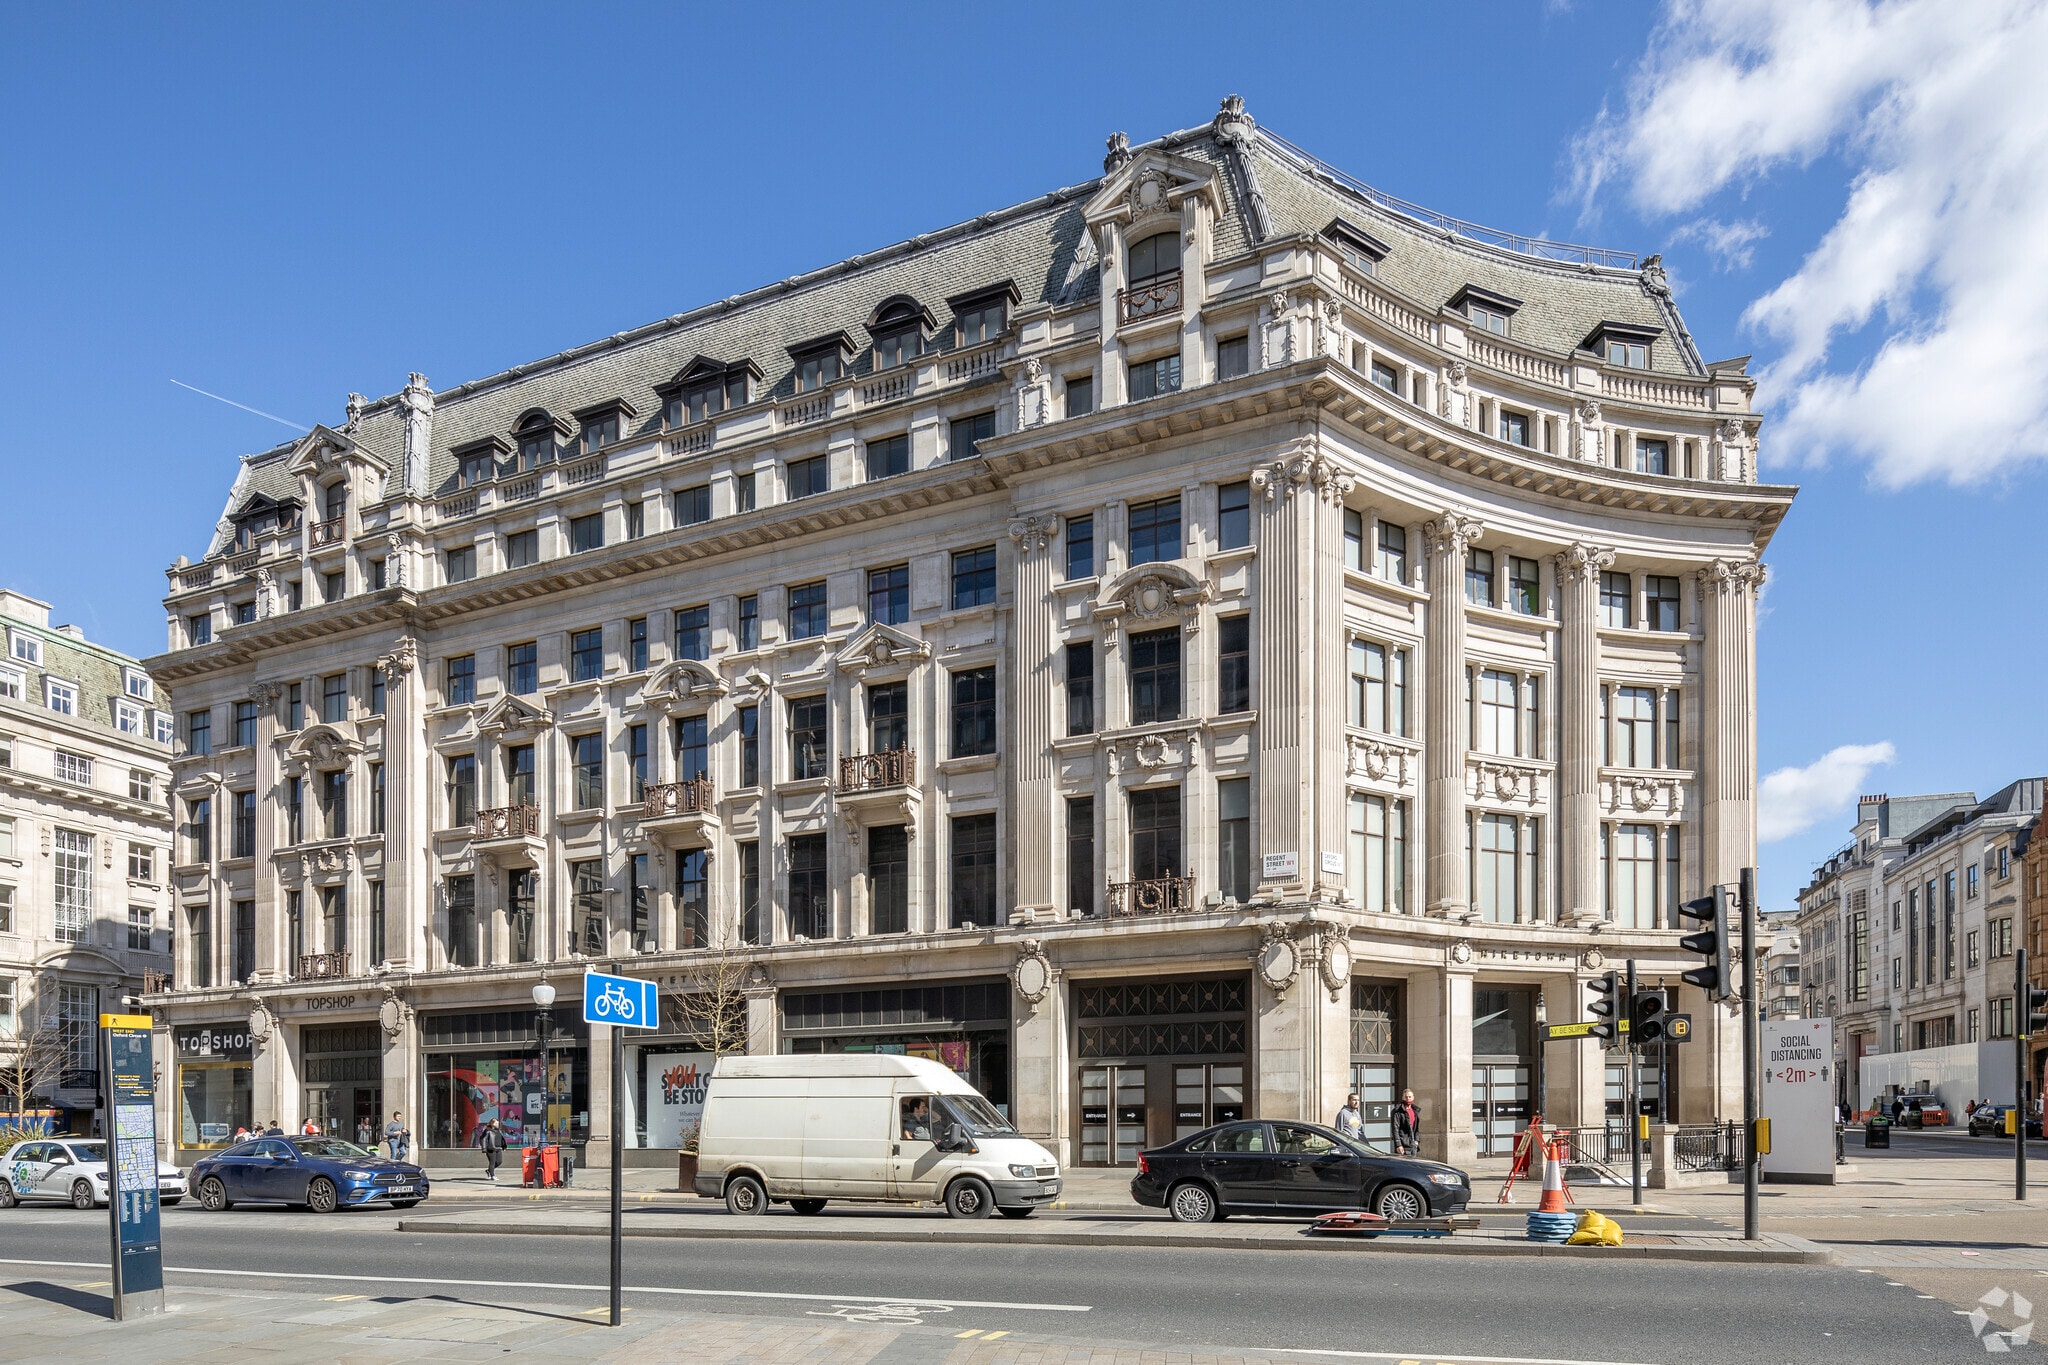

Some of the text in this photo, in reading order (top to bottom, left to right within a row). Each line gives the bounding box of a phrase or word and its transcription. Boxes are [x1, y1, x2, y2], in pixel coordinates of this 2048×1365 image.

[1480, 950, 1566, 962] NIKETOWN
[306, 996, 355, 1010] TOPSHOP
[180, 1034, 252, 1051] TOPSHOP
[1780, 1035, 1810, 1047] SOCIAL
[1771, 1048, 1822, 1061] DISTANCING
[1786, 1067, 1806, 1082] 2m
[664, 1090, 679, 1104] BE
